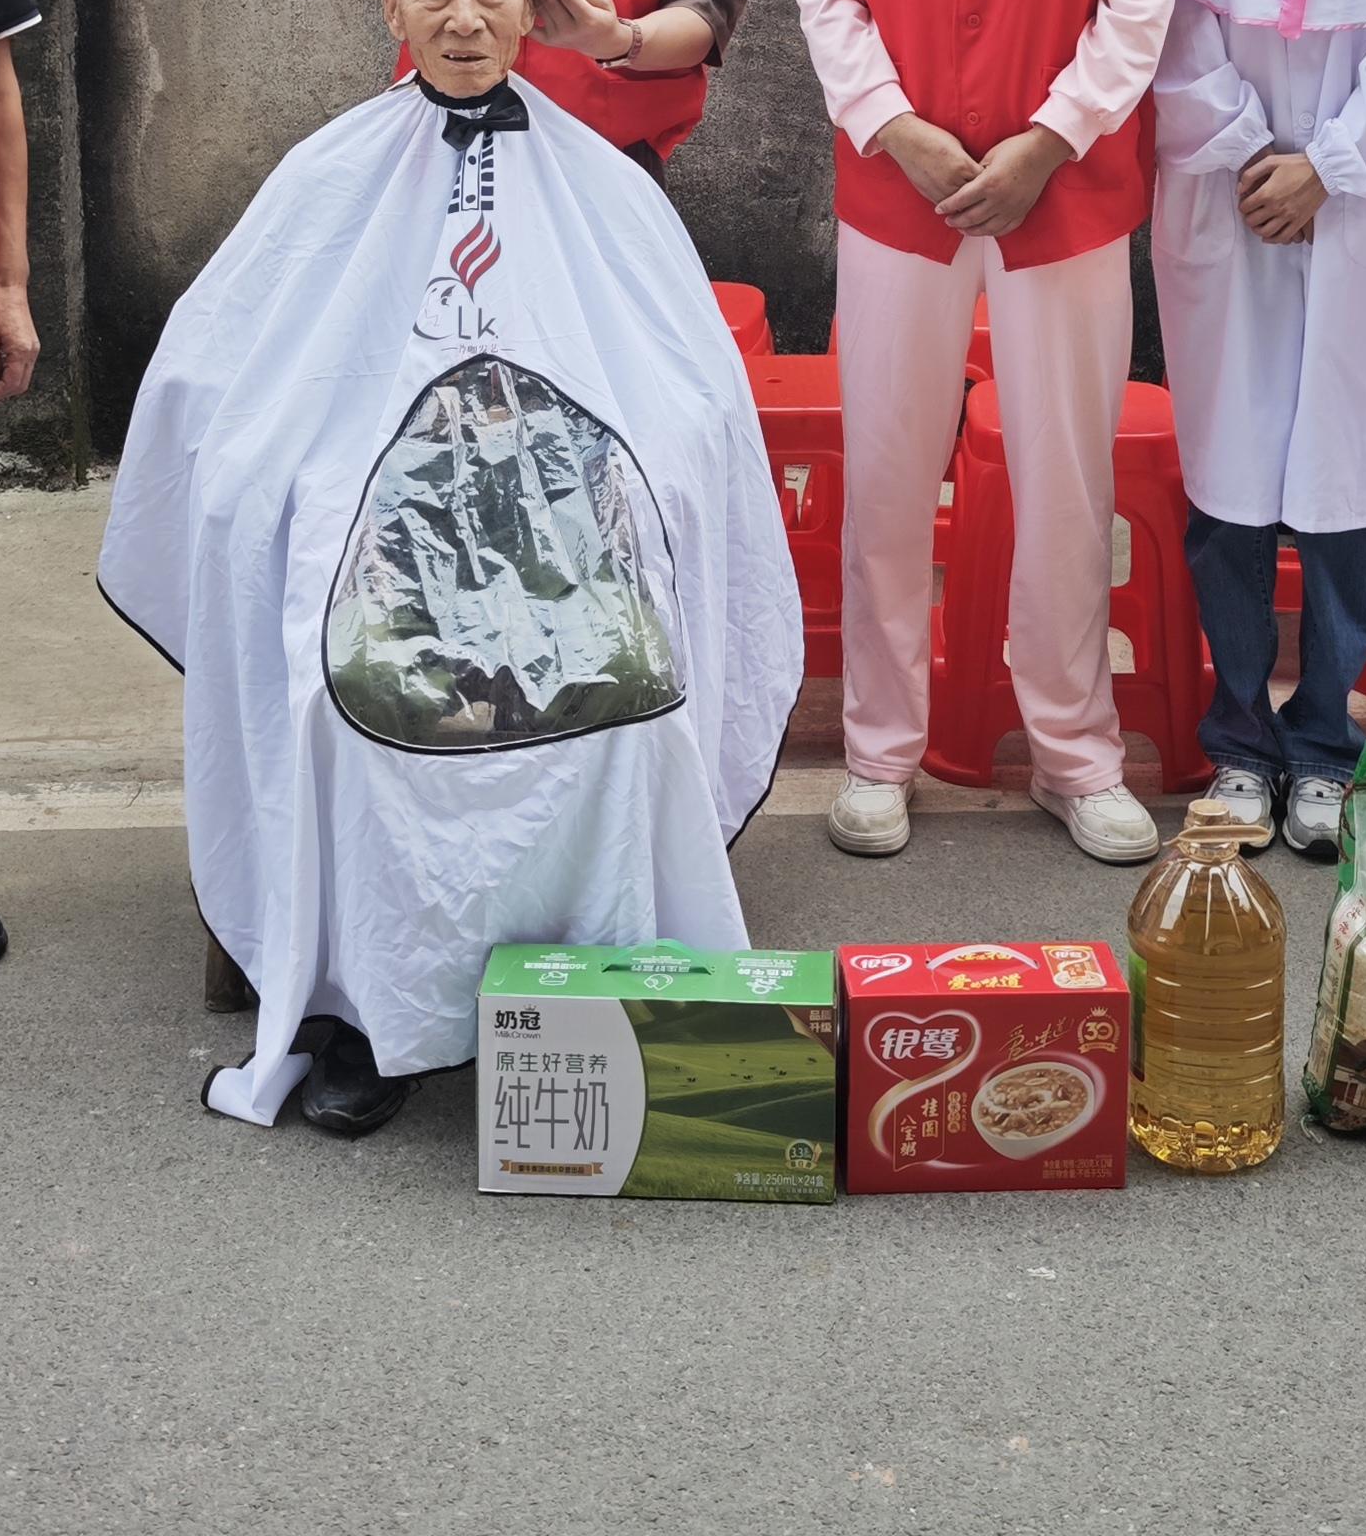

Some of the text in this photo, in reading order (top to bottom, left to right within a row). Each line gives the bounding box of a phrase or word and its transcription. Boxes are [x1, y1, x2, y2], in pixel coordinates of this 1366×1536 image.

[494, 1009, 541, 1031] 奶冠
[1084, 1021, 1114, 1042] 30
[880, 1028, 960, 1060] 银鹭
[496, 1051, 608, 1075] 原生好营养
[494, 1076, 609, 1152] 纯牛奶
[899, 1114, 917, 1157] 八宝粥
